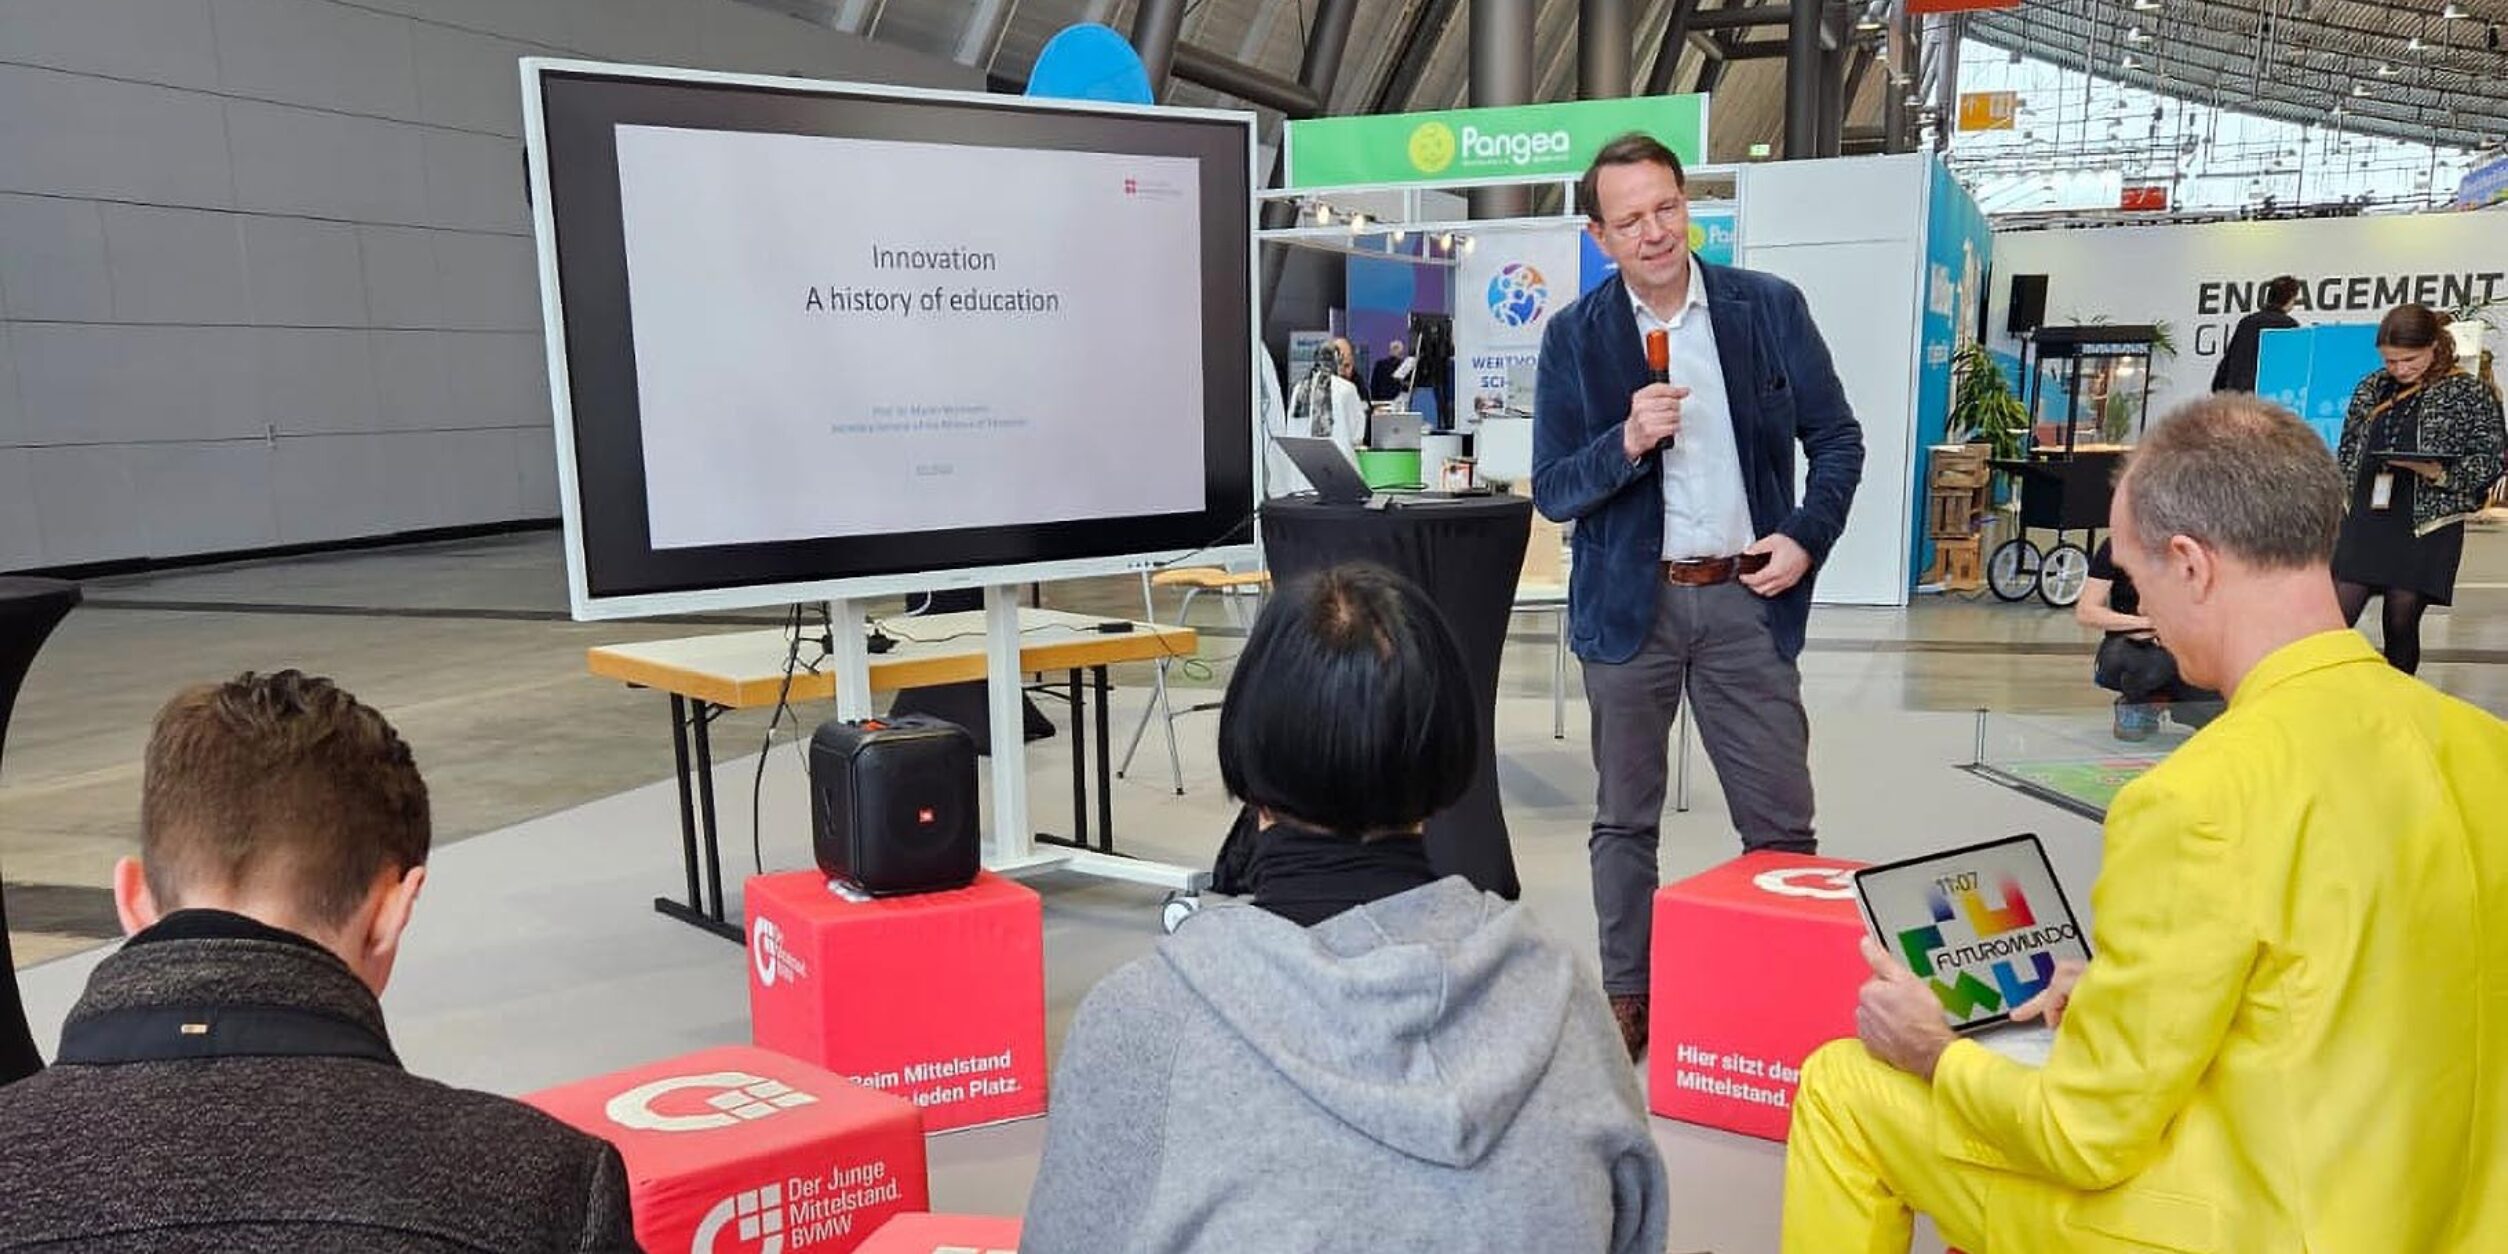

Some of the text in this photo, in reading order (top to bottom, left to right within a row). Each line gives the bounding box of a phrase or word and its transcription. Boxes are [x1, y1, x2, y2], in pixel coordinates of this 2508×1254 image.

[1461, 126, 1570, 165] Pangea
[872, 244, 996, 271] Innovation
[806, 286, 1059, 317] A history of education
[1472, 356, 1538, 369] WERTVO
[1936, 872, 1978, 896] 11:07
[1936, 923, 2081, 971] FUTUROMUNDO
[904, 1049, 1012, 1085] Mittelstand
[1677, 1043, 1718, 1068] Hier
[1721, 1053, 1765, 1077] sitzt
[969, 1077, 1022, 1098] Platz.
[1676, 1069, 1790, 1108] Mittelstand.
[788, 1161, 885, 1201] Der Junge
[789, 1177, 903, 1226] Mittelstand.
[791, 1213, 853, 1249] BVMW
